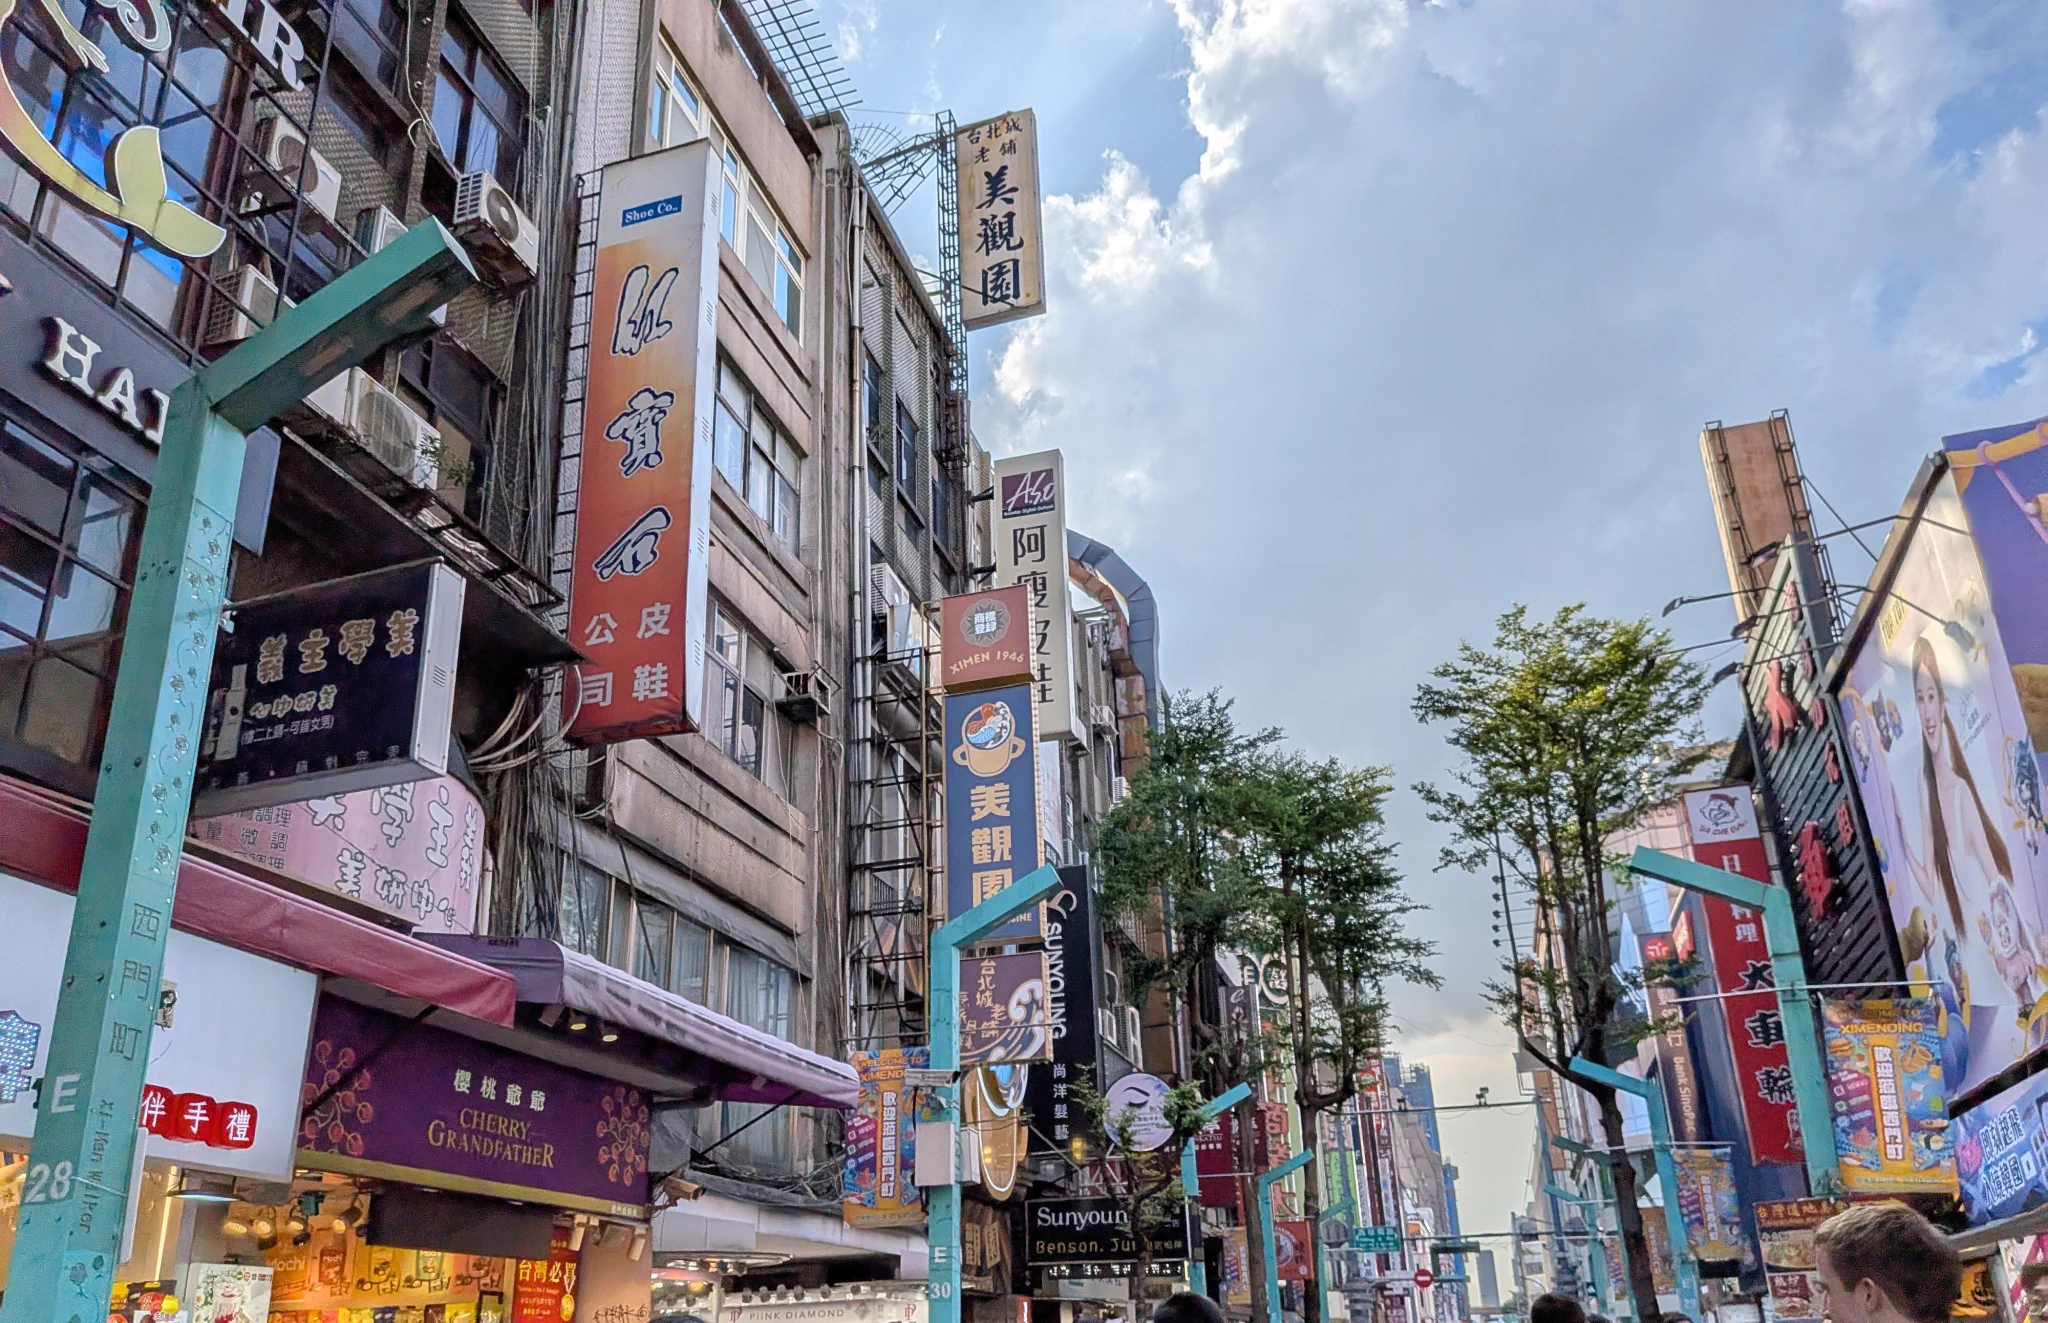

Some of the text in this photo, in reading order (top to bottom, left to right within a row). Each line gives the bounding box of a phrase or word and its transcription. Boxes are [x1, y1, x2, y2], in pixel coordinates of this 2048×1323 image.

[966, 117, 1023, 146] 台北城
[625, 208, 655, 224] Shoe
[975, 164, 1025, 307] 美觀園
[581, 612, 619, 707] 公司
[632, 601, 671, 702] 皮鞋
[949, 650, 1024, 675] XIMEN 1946
[110, 902, 163, 1062] 西門町
[1045, 921, 1068, 1040] SUNYOUNG
[1840, 1022, 1924, 1035] XIMENDING
[858, 1056, 923, 1068] WELCOME TO
[860, 1069, 906, 1082] XIMEND
[1672, 1055, 1687, 1086] Bank
[50, 1073, 82, 1115] E
[453, 1068, 547, 1112] 櫻桃爺爺
[141, 1090, 251, 1142] 伴手禮
[459, 1108, 532, 1140] CHERRY
[427, 1119, 555, 1169] GRANDFATHER
[24, 1160, 74, 1203] 28
[1037, 1207, 1130, 1231] Sunyoun
[933, 1246, 947, 1264] E
[930, 1281, 951, 1299] 30
[785, 1308, 845, 1321] DIAMOND
